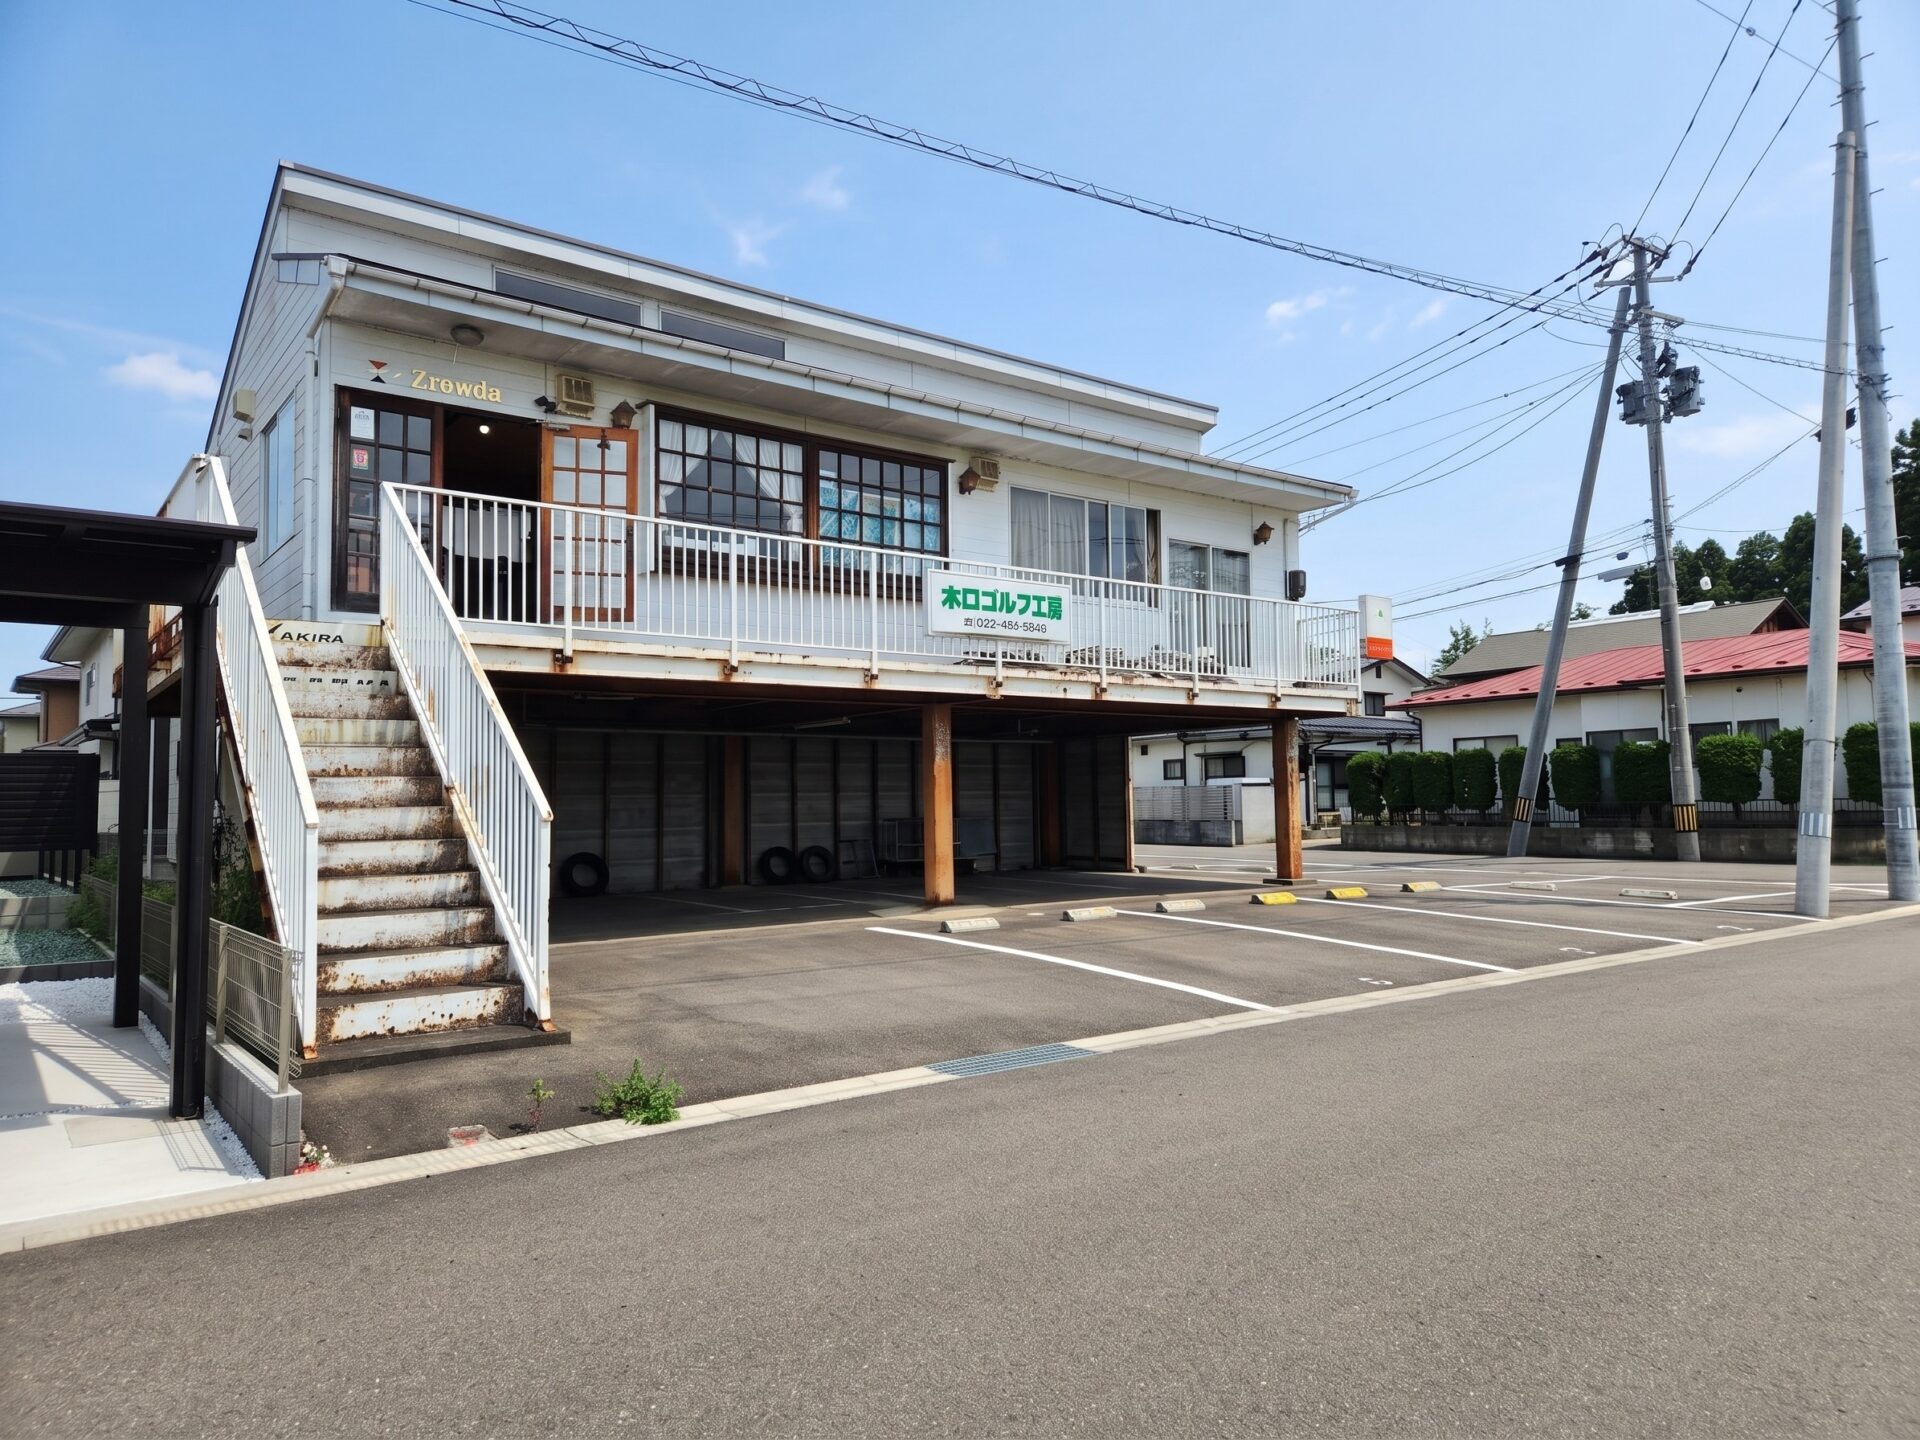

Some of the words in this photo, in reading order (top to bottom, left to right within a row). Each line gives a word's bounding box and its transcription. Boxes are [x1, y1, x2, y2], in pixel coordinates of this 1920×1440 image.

[410, 369, 502, 403] Zrowda
[941, 585, 1063, 621] 木口ゴルフ工房
[280, 631, 344, 643] AKIRA
